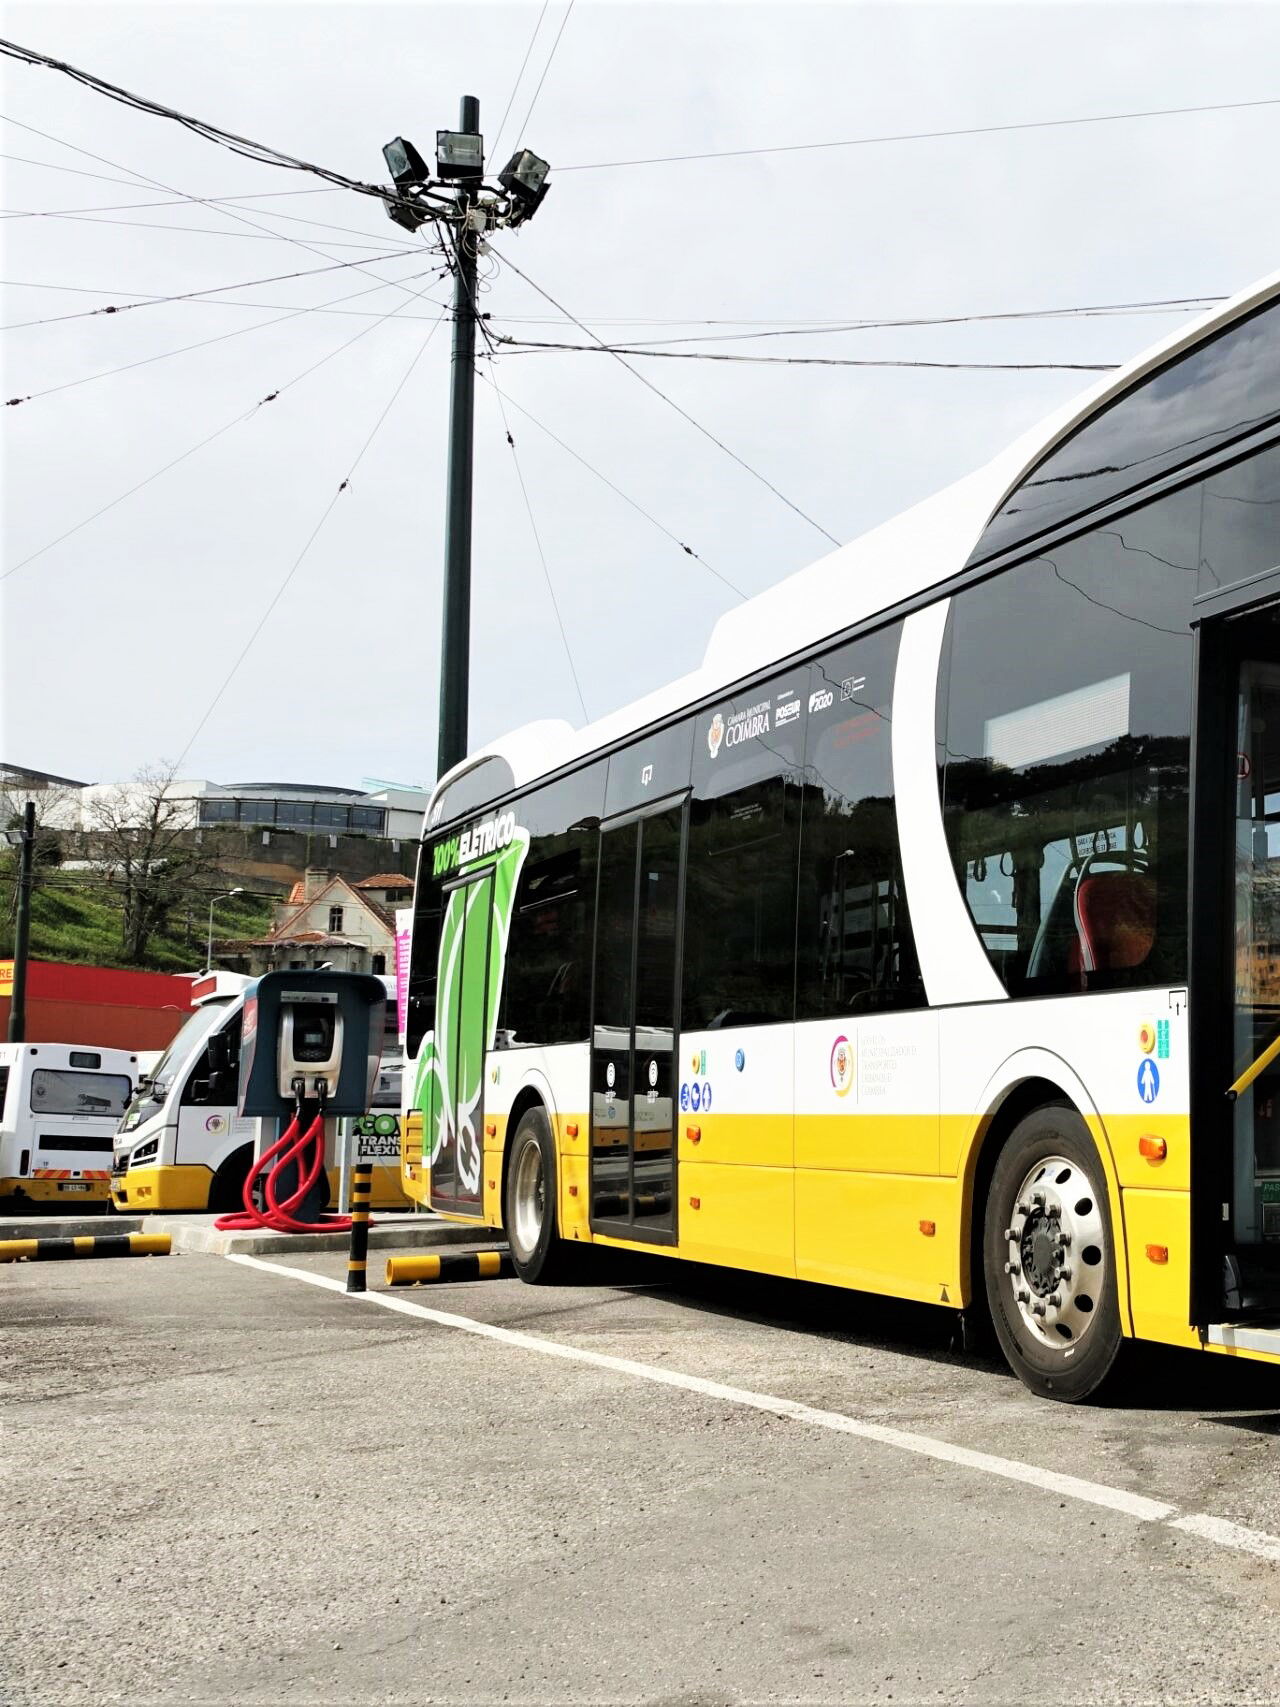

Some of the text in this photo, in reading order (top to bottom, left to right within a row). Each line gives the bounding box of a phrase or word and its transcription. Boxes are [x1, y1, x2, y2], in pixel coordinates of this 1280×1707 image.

[814, 692, 833, 711] 2020
[726, 712, 769, 747] COIMBRA
[433, 836, 461, 875] 100%
